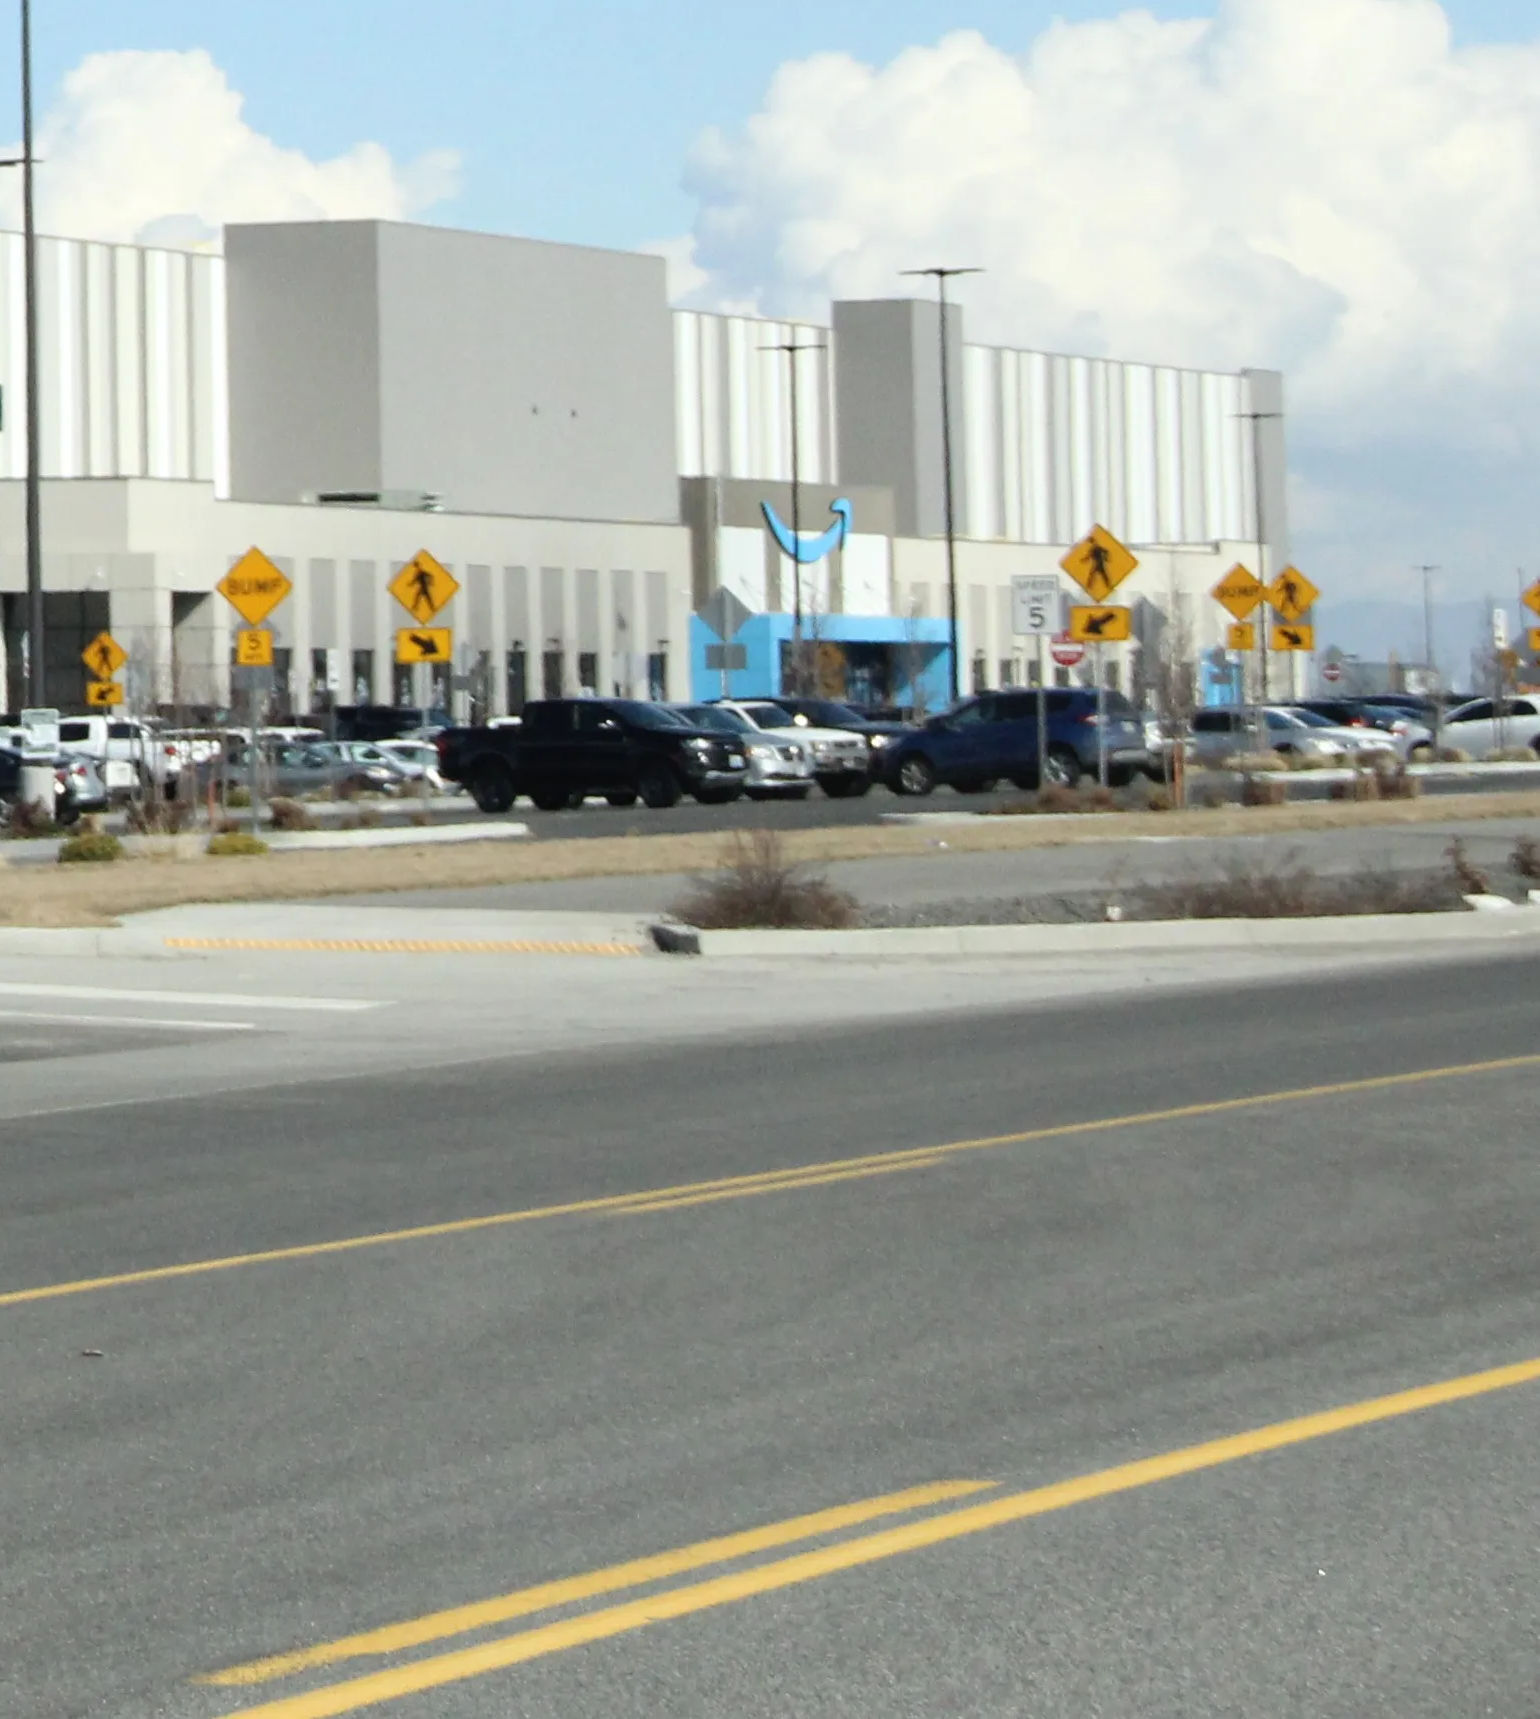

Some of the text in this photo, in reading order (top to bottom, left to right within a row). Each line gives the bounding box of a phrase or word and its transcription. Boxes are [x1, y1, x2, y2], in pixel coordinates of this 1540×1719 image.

[227, 578, 282, 596] BUMP
[1029, 606, 1046, 628] 5
[247, 633, 263, 651] 5
